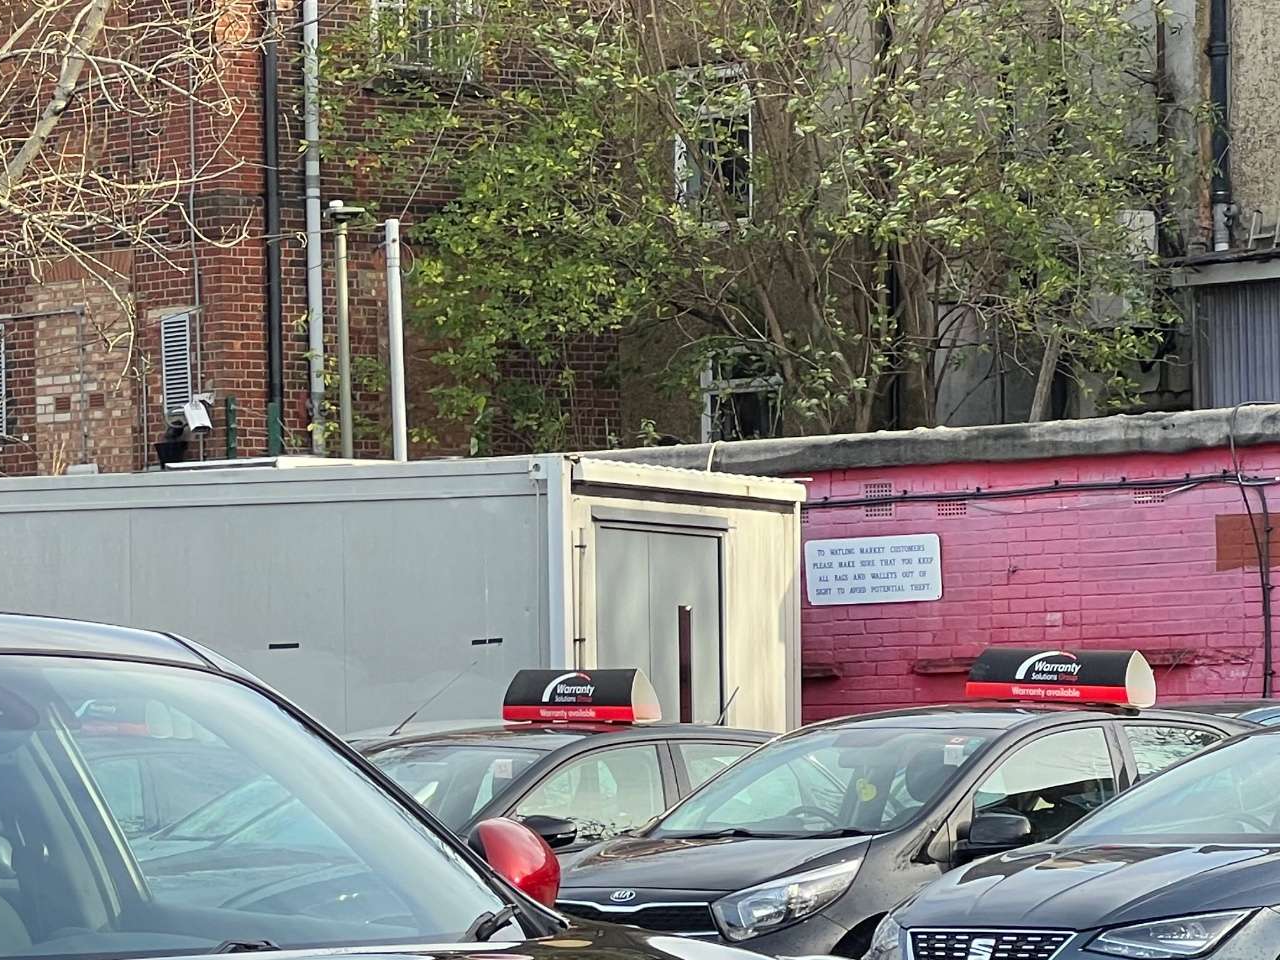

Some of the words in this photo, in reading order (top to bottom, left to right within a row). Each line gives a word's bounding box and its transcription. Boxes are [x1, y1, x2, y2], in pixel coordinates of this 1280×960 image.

[859, 546, 885, 554] MARKET
[812, 561, 833, 569] PLEASE
[838, 560, 856, 568] MAKE
[880, 558, 896, 566] THAT
[871, 571, 897, 579] WALLETS
[871, 584, 905, 592] POTENTIAL
[1034, 661, 1081, 675] Warranty
[1031, 673, 1057, 681] Solutions
[556, 684, 595, 696] Warranty
[1011, 687, 1045, 697] Warranty
[1046, 688, 1080, 697] available
[540, 709, 567, 719] Warranty
[568, 709, 596, 717] available
